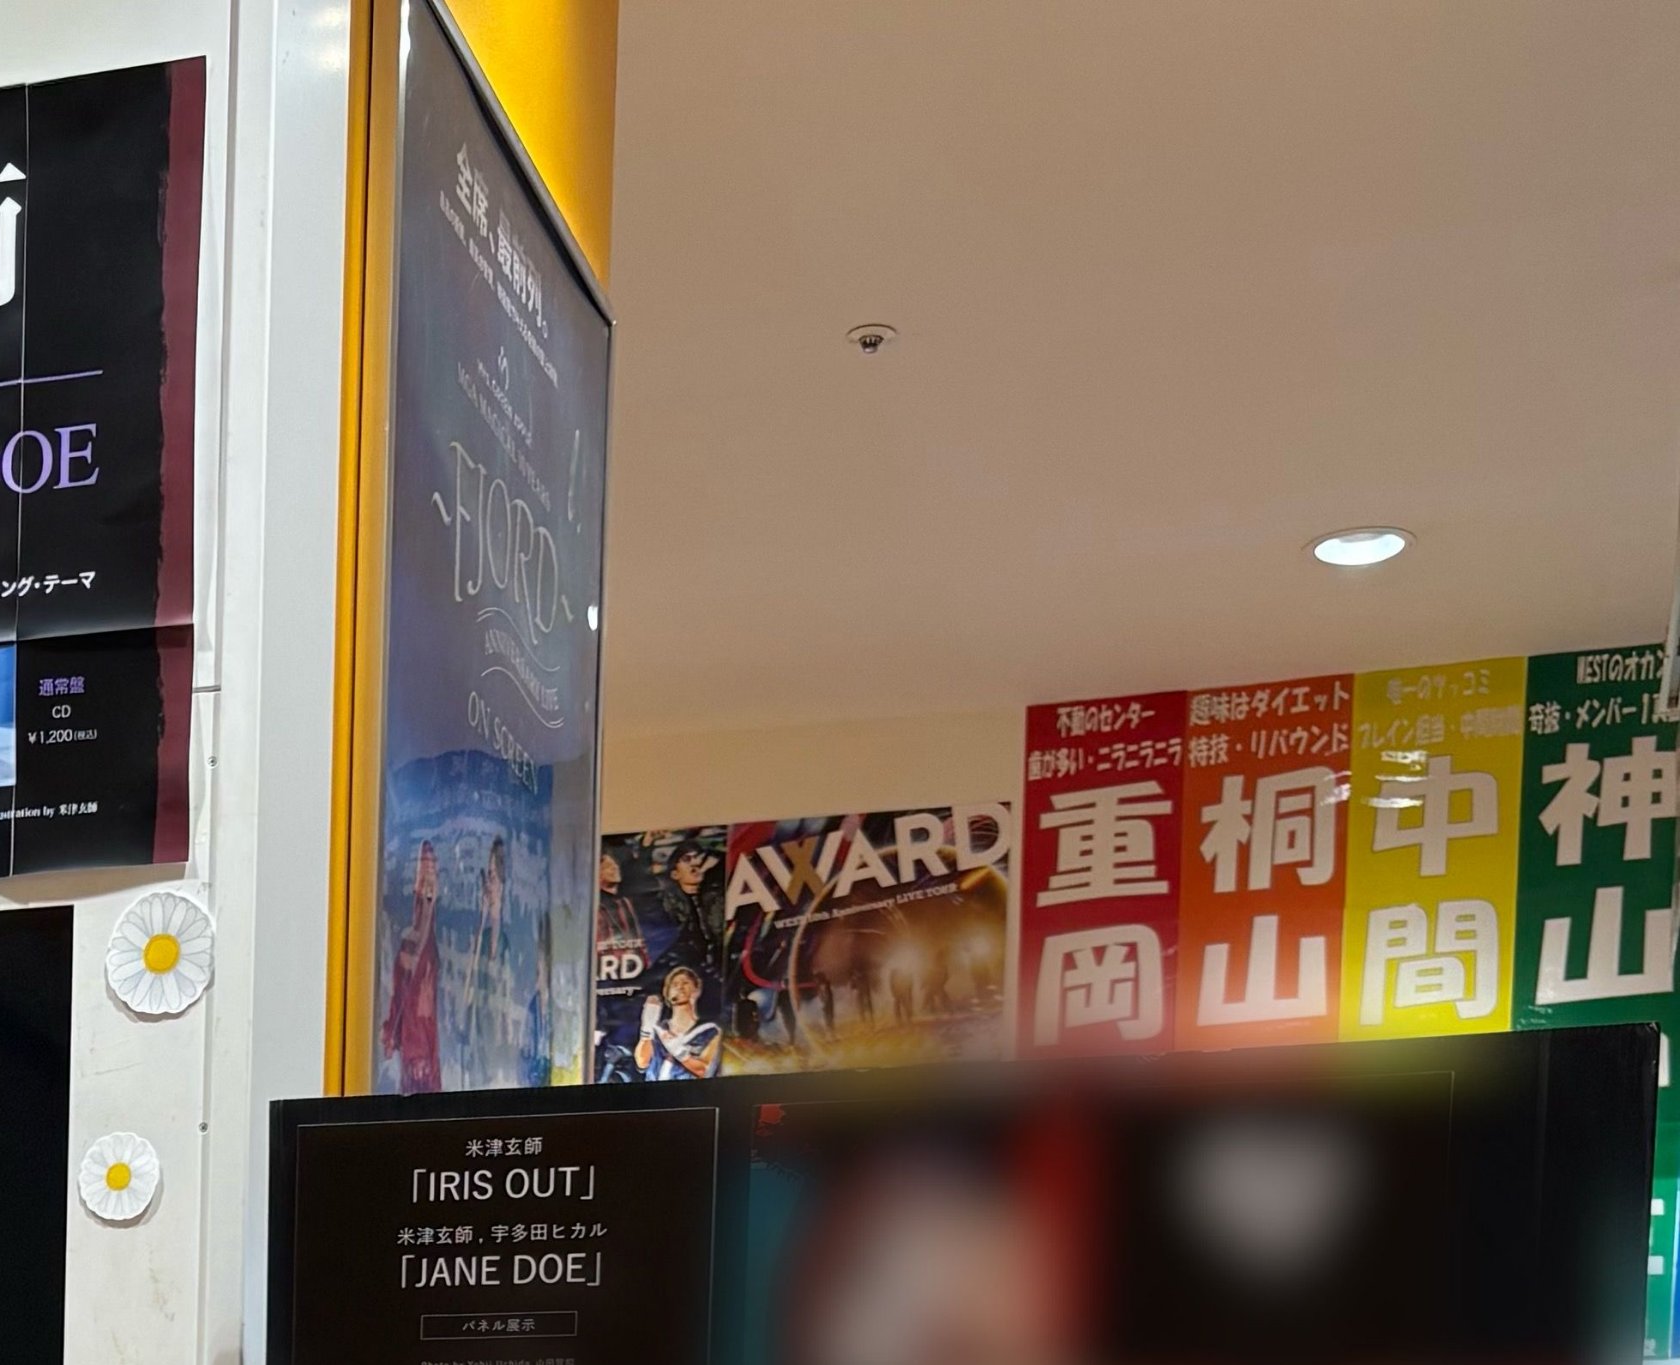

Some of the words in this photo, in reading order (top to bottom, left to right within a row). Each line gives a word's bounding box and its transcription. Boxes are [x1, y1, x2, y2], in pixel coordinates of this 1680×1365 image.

[38, 675, 86, 697] 通常盤
[51, 704, 72, 719] CD
[1189, 680, 1350, 726] 趣味はダイエット
[1056, 701, 1156, 738] 不動のセンター
[42, 805, 55, 818] by
[1196, 764, 1336, 1029] 桐山
[1359, 755, 1501, 1029] 中間
[1032, 780, 1174, 1047] 重岡
[465, 1136, 543, 1158] 米津玄師
[490, 1222, 608, 1244] 宇多田ヒカル
[462, 1317, 537, 1334] パネル展示
